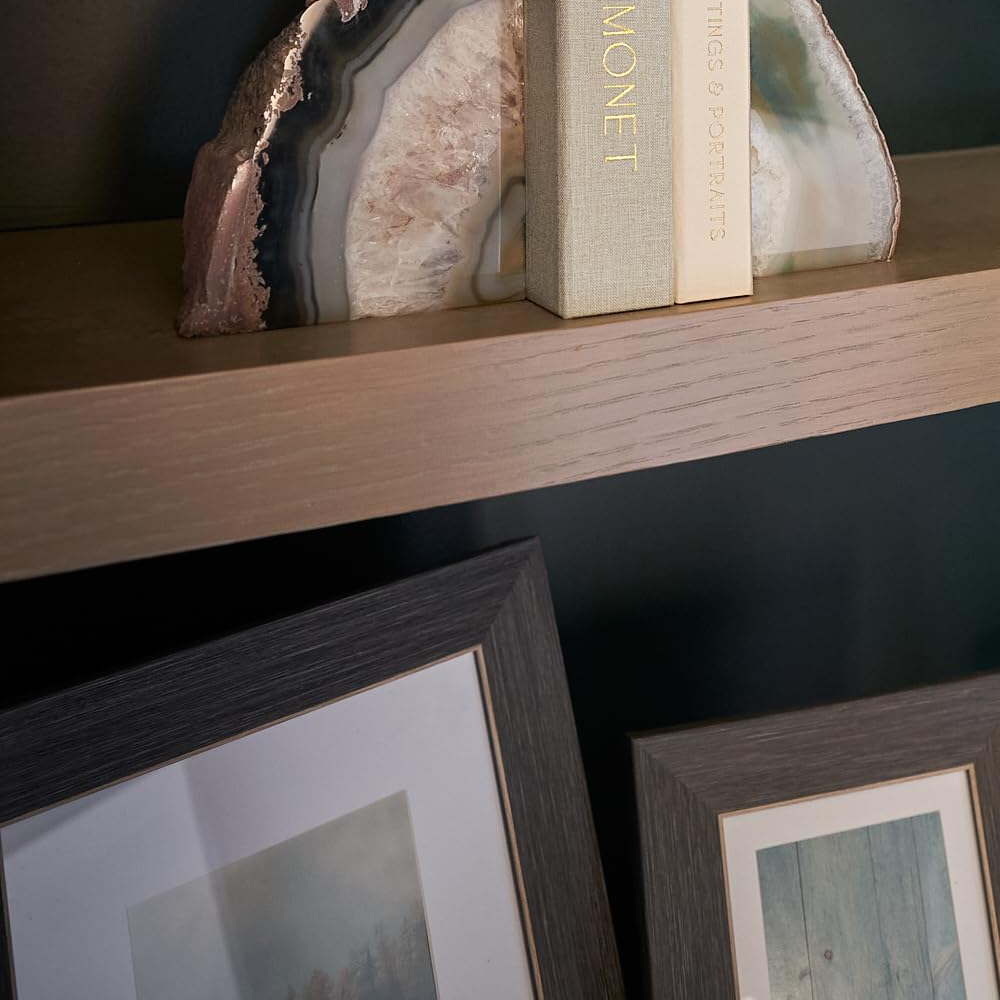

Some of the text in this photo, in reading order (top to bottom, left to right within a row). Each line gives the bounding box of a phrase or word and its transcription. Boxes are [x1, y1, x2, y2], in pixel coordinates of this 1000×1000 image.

[602, 3, 637, 173] MONET
[708, 80, 724, 97] &
[708, 106, 726, 242] PORTRAITS
